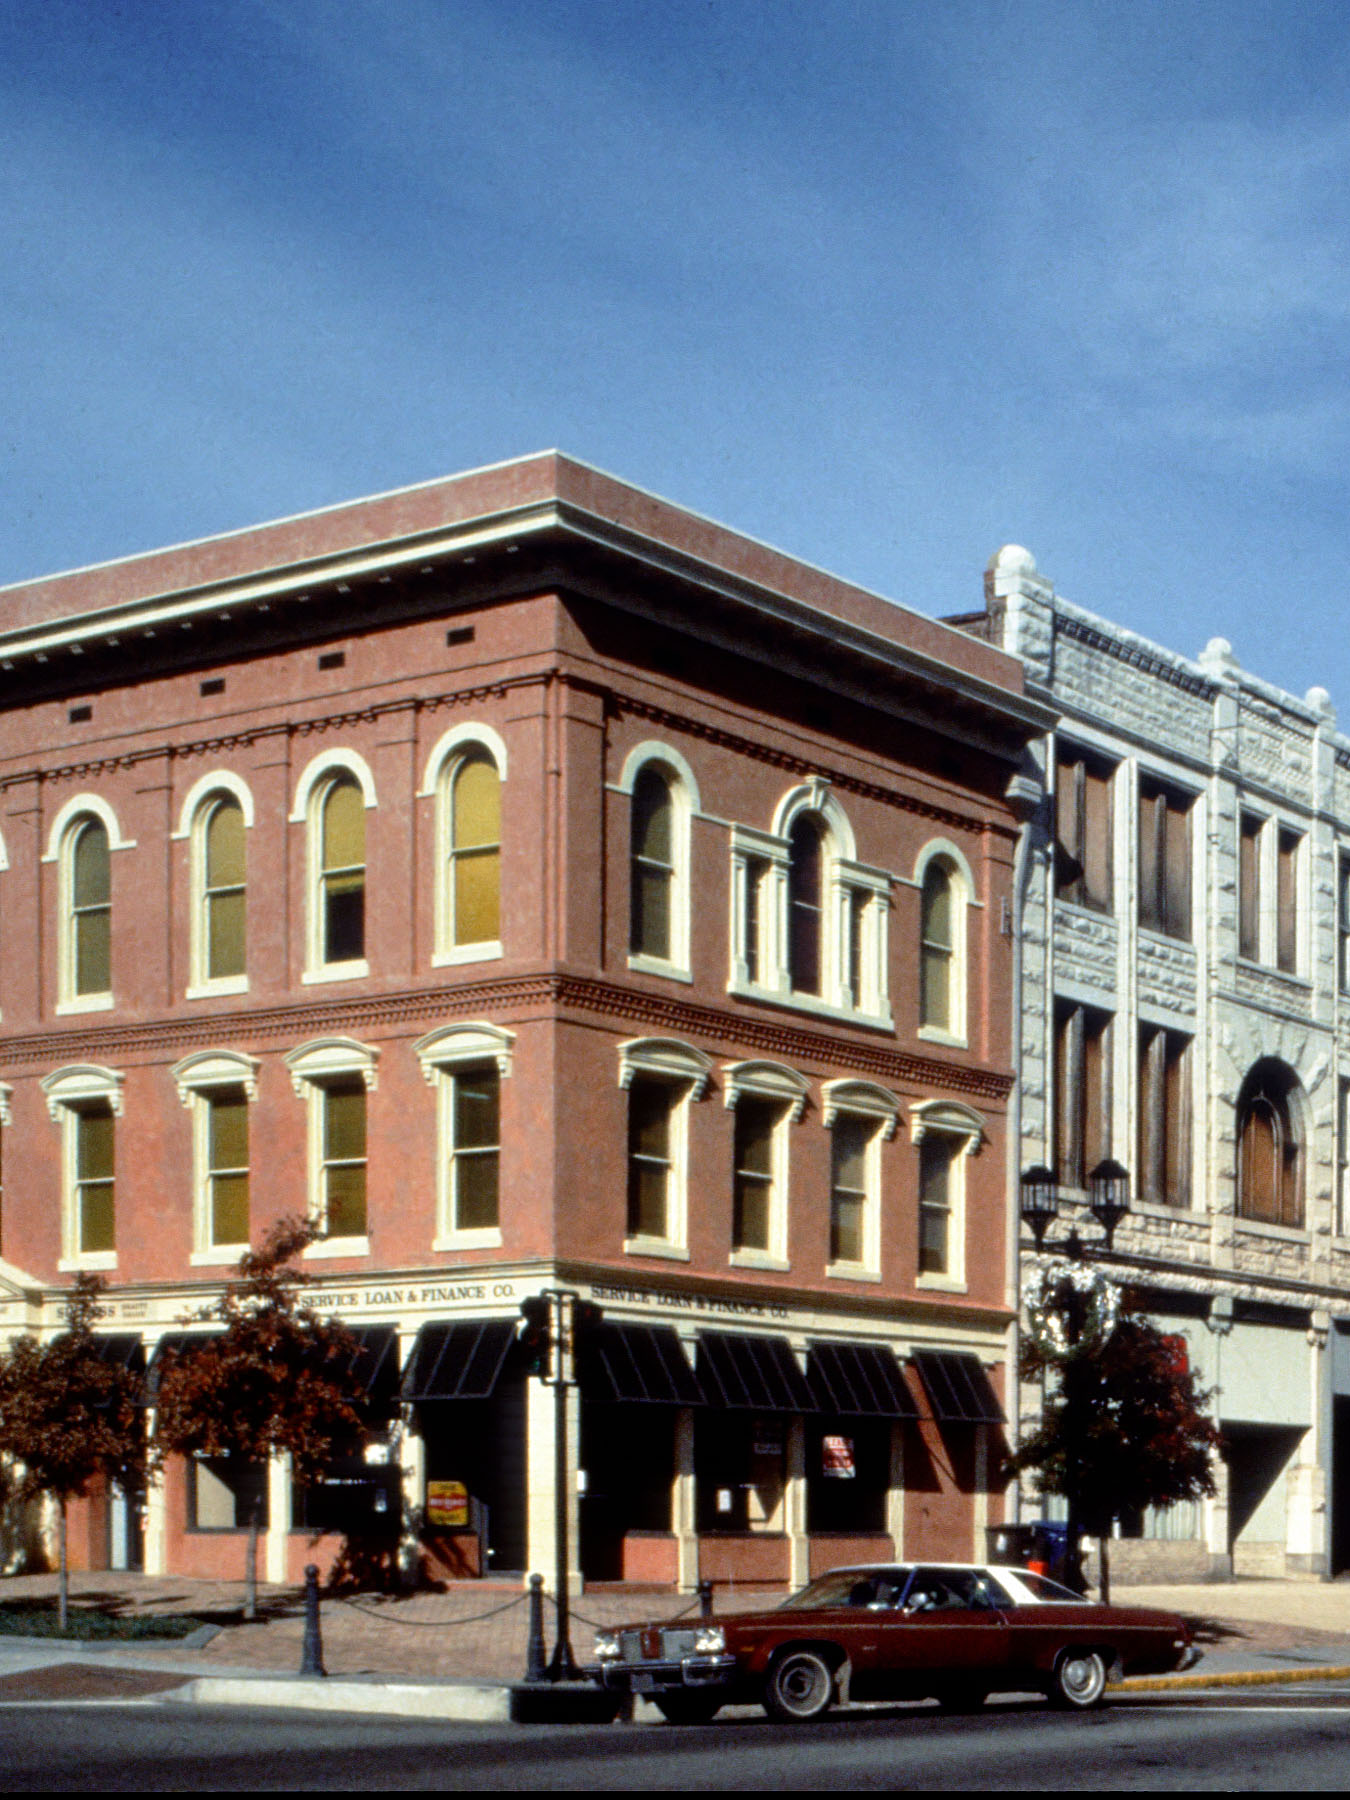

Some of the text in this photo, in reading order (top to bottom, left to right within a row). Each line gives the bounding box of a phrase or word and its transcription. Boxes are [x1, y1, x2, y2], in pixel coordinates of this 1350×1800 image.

[301, 1284, 514, 1308] SERVICE LOAN & FINANCE CO.
[591, 1285, 650, 1304] SERVICE
